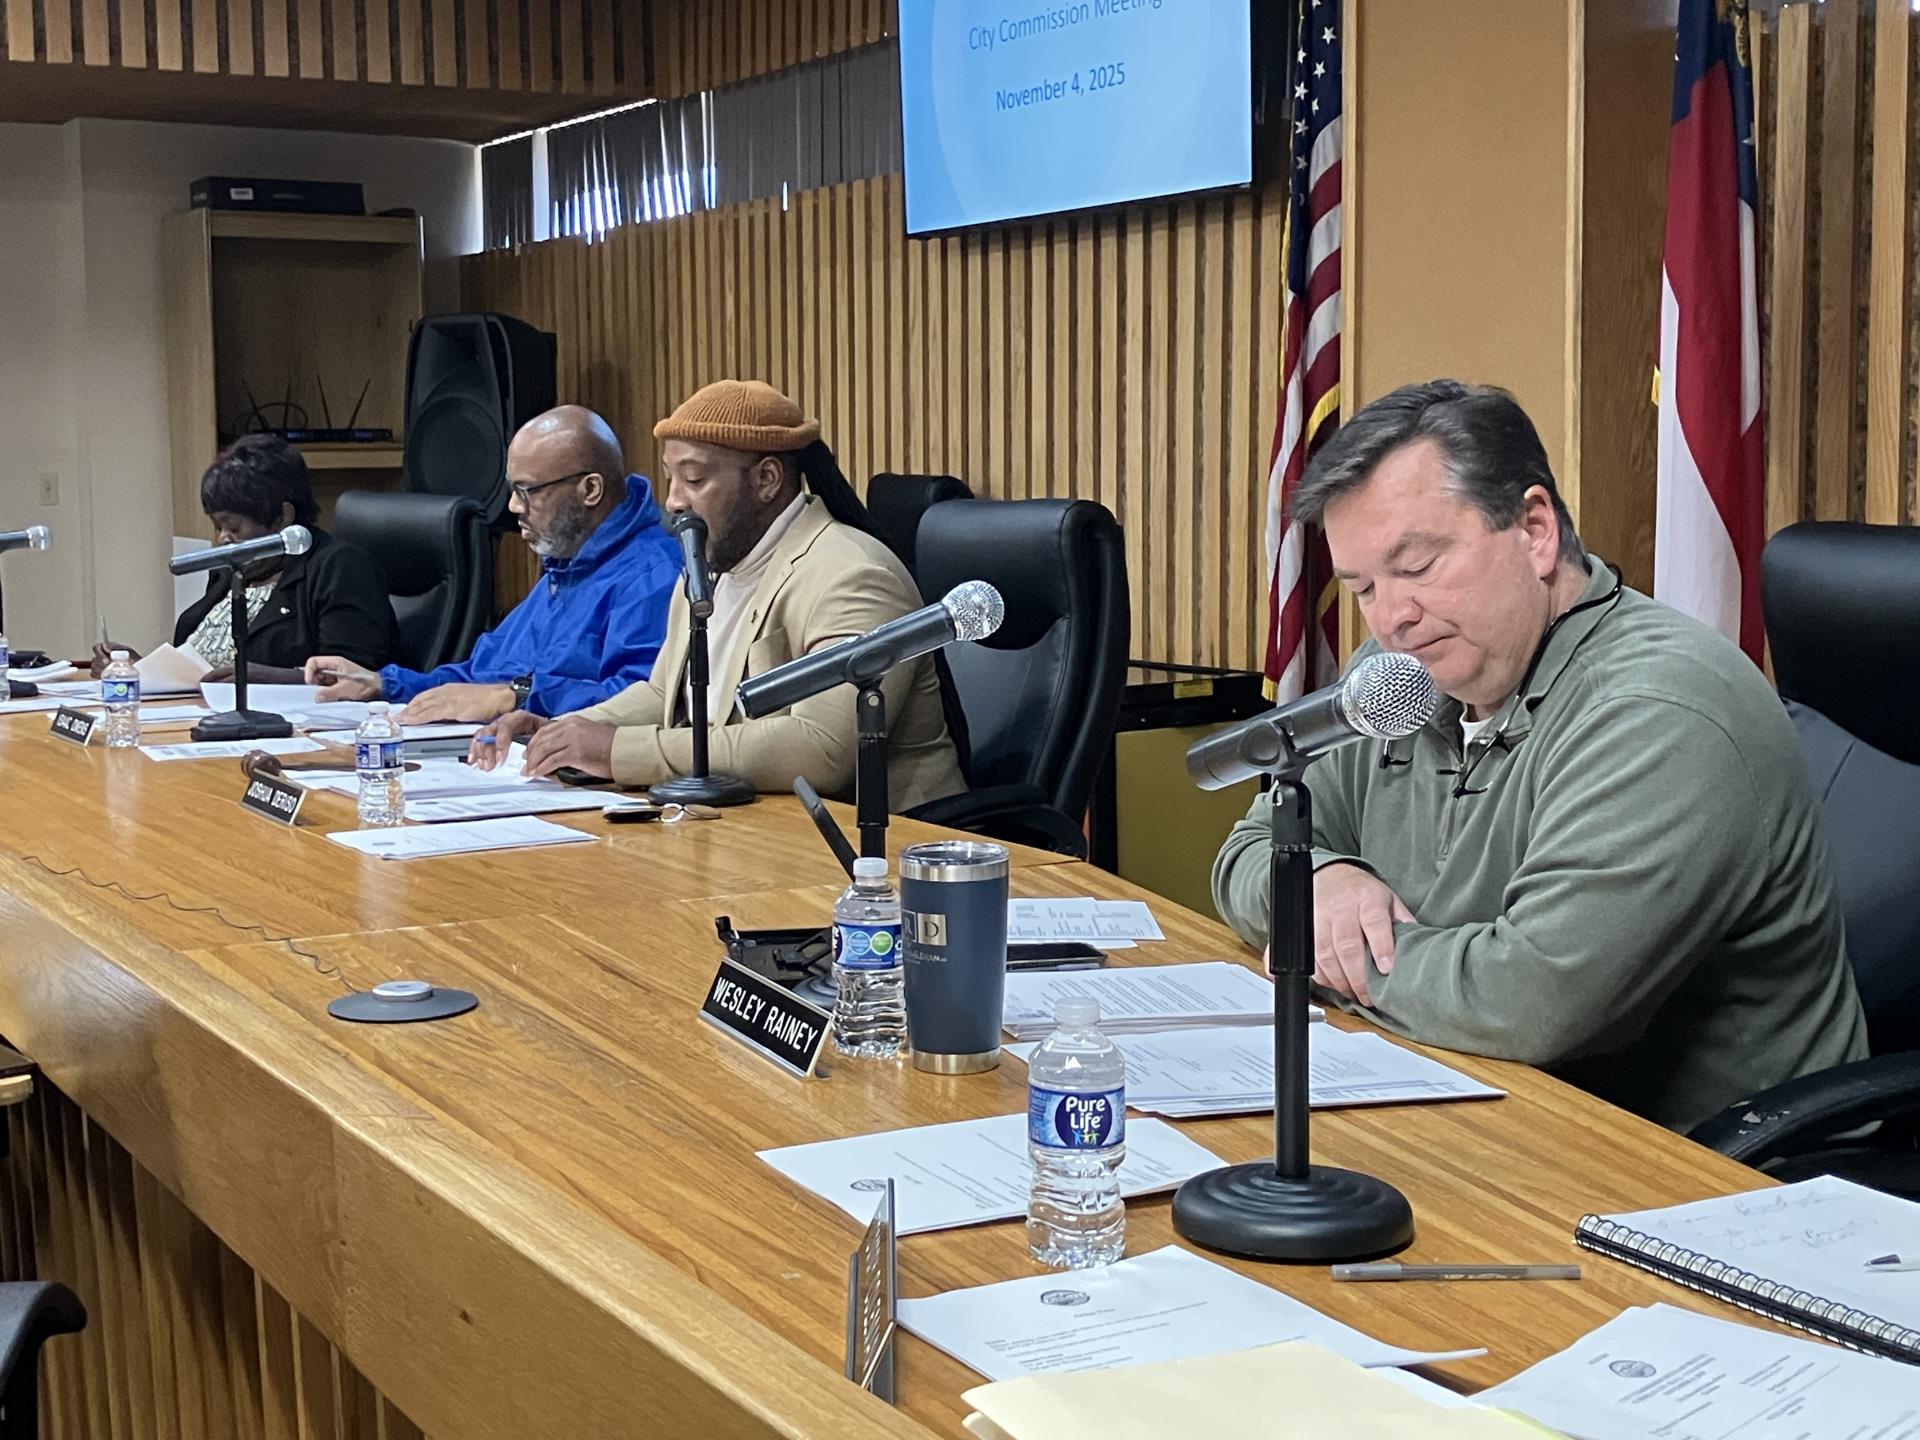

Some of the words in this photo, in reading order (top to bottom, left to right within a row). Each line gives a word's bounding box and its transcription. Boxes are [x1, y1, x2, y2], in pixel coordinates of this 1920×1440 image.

[969, 27, 996, 51] City
[999, 3, 1089, 42] Commission
[997, 78, 1067, 111] November
[1071, 73, 1085, 97] 4,
[1089, 62, 1126, 92] 2025
[924, 921, 940, 939] D
[713, 977, 765, 1023] WESLEY
[764, 1006, 819, 1054] RAINEY
[1065, 1096, 1106, 1112] Pure
[1070, 1113, 1101, 1133] Life
